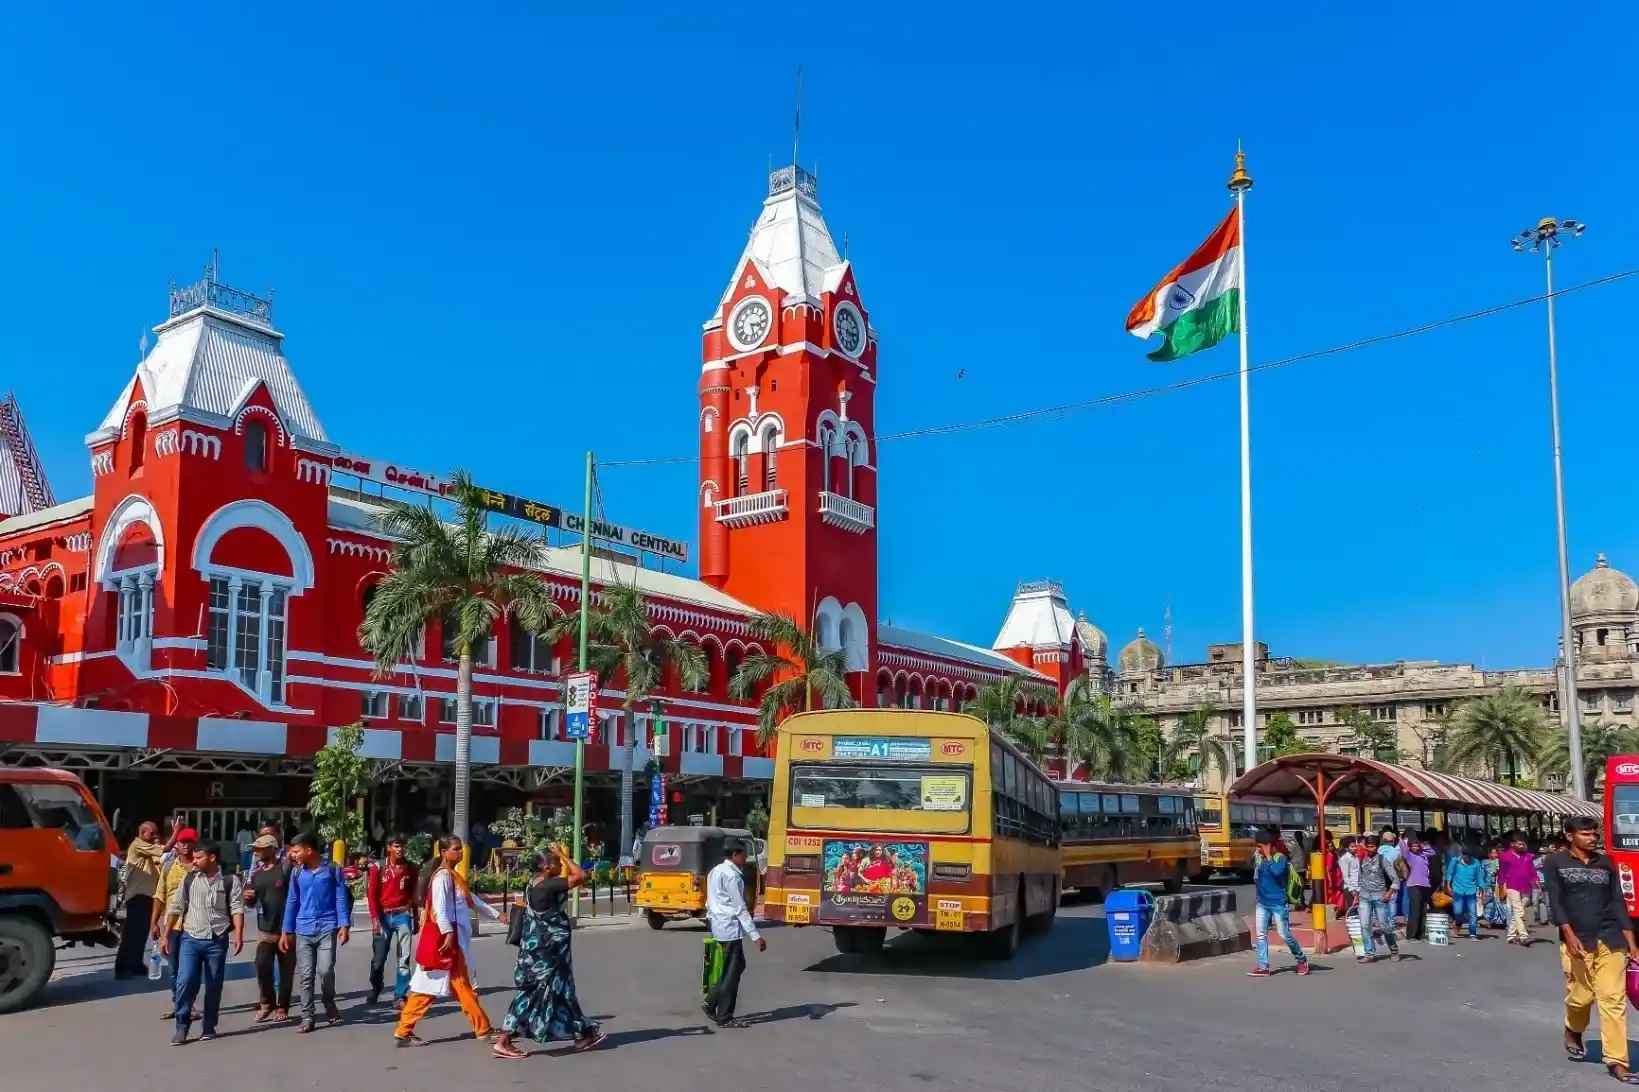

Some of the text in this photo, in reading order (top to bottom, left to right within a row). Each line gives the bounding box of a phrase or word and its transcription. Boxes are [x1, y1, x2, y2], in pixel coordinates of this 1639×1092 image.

[631, 532, 685, 557] CENTRAL
[801, 740, 822, 751] MTC
[871, 744, 890, 756] A1
[942, 743, 963, 754] MTC
